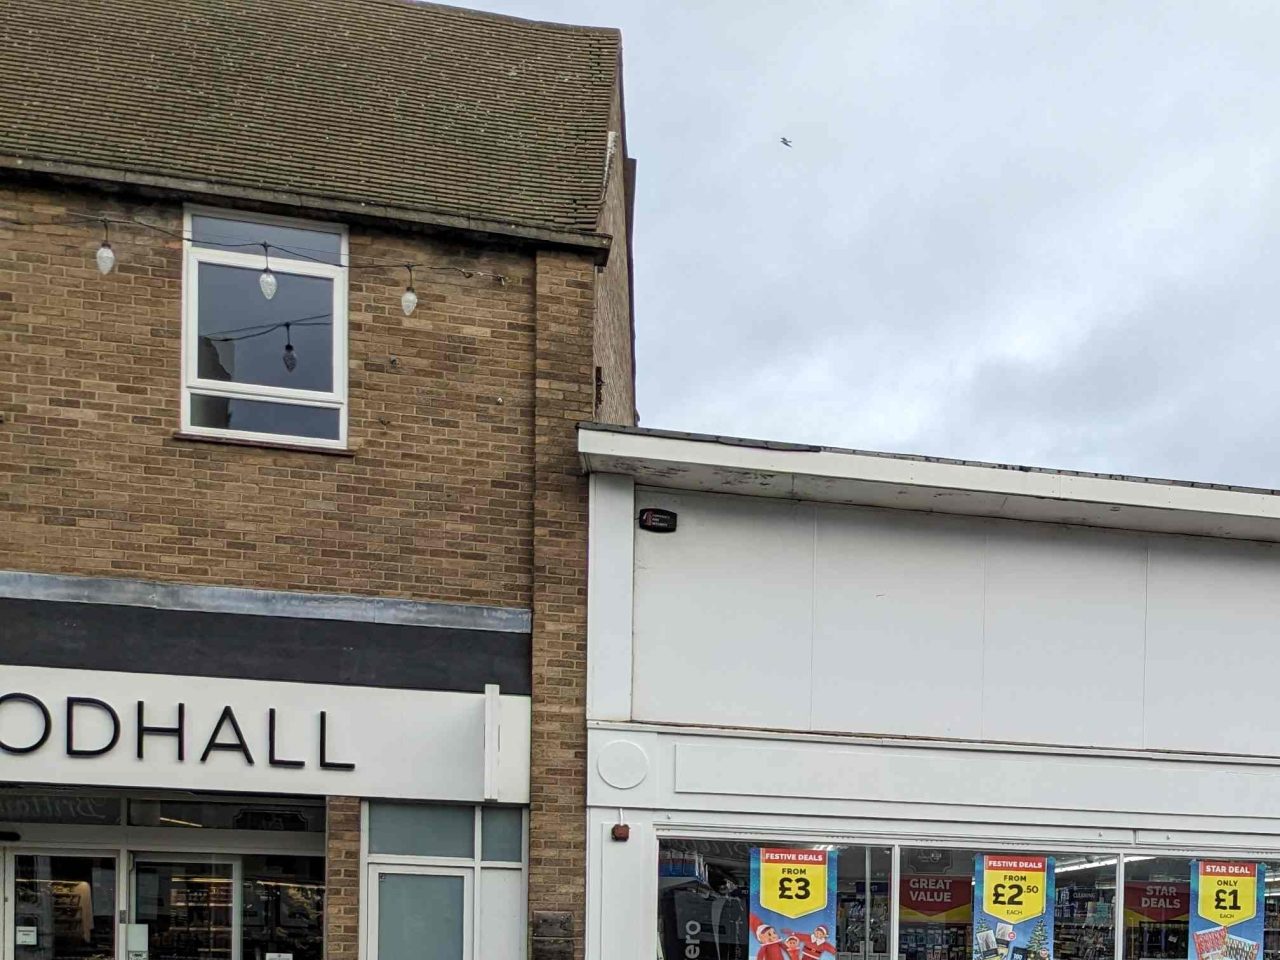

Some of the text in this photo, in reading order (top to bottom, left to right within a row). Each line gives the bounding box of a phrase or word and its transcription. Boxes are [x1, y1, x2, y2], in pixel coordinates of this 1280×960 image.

[779, 877, 810, 900] £3
[909, 879, 953, 890] GREAT
[1145, 885, 1177, 896] STAR
[909, 891, 952, 902] VALUE
[1214, 888, 1241, 911] £1
[1141, 897, 1181, 909] DEALS
